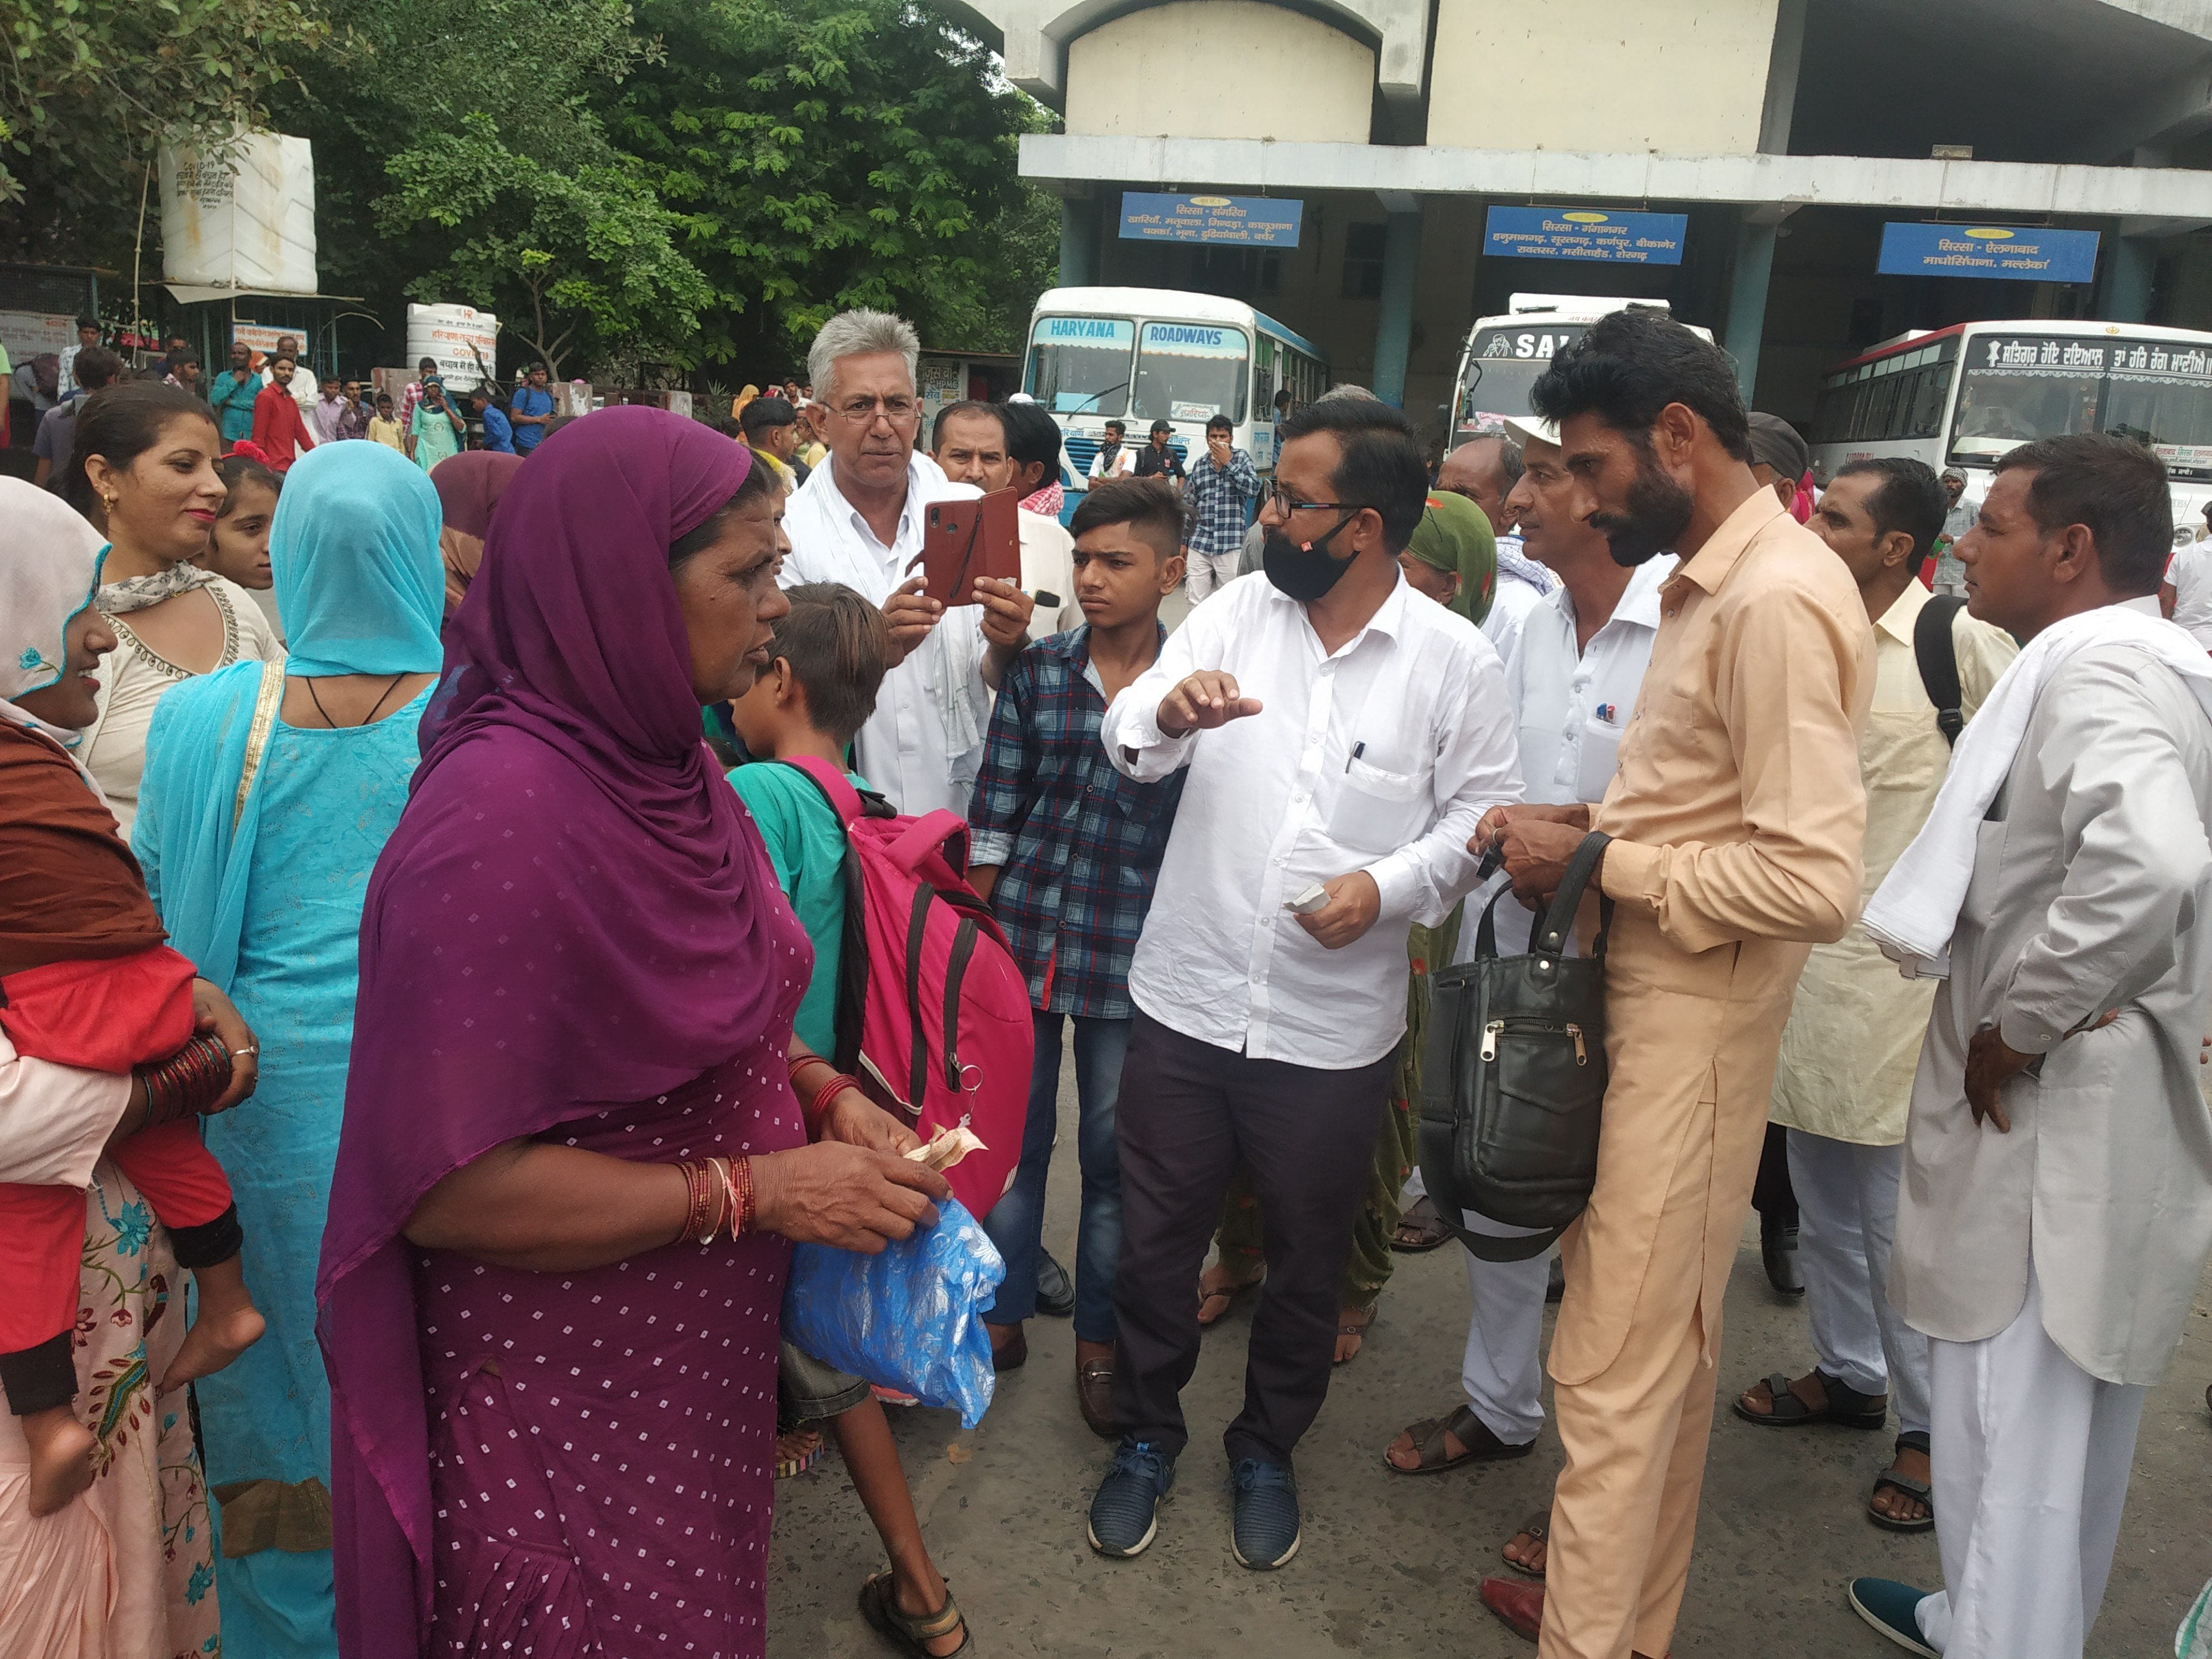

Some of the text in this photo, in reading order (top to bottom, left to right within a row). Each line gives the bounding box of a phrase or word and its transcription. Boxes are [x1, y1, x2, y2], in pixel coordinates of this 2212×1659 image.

[1176, 204, 1203, 215] सिरसा
[1542, 220, 1573, 232] सिरसा
[1581, 222, 1628, 234] गंगानगर
[1938, 238, 1975, 252] सिरसा
[1985, 241, 2039, 255] ऐलनाबाद
[1051, 320, 1223, 345] HARYANA ROADWAYS
[2114, 346, 2127, 367] ਤਾਂ
[2129, 346, 2147, 368] ਹਰਿ
[2150, 347, 2168, 370] ਰੰਗ
[1061, 427, 1084, 437] रियाणा
